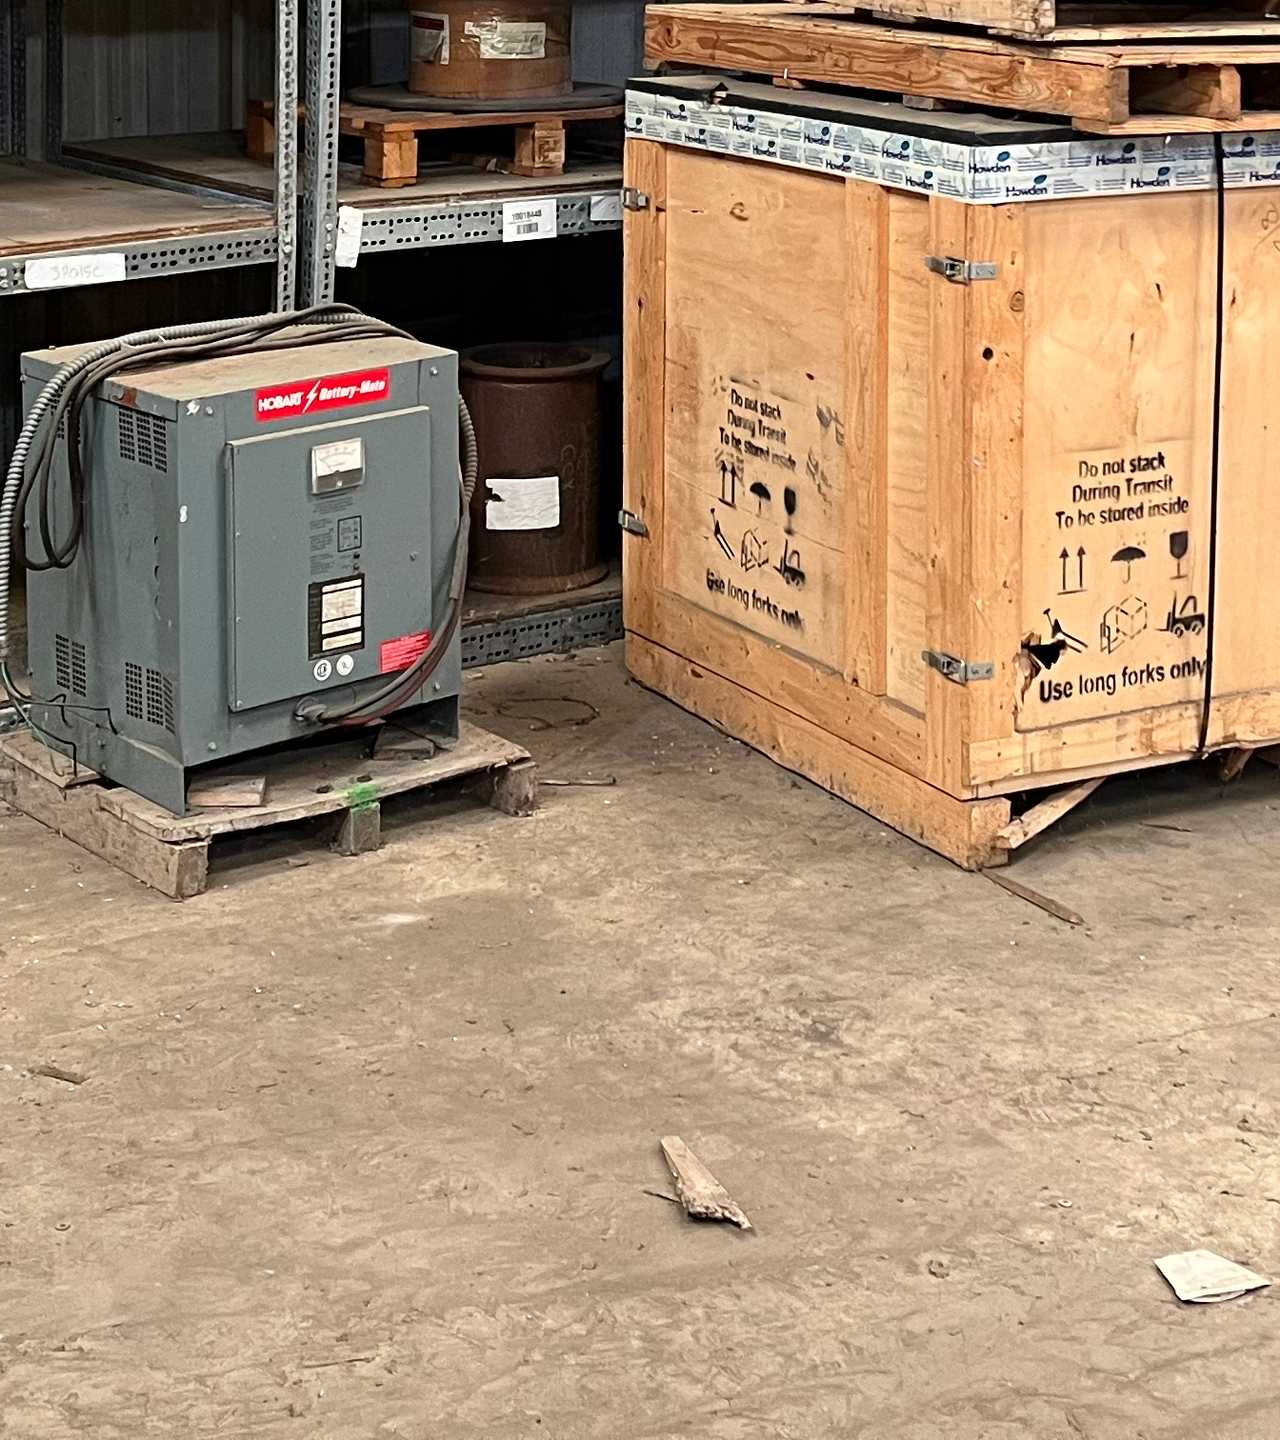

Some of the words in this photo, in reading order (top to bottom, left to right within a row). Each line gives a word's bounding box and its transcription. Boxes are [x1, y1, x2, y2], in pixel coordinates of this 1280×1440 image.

[968, 162, 1012, 174] Howden
[1096, 153, 1136, 166] Howden
[1006, 185, 1048, 198] Howden
[1131, 177, 1171, 189] Howden
[258, 391, 304, 413] HOBART
[731, 388, 743, 406] Do
[760, 401, 782, 421] stack
[719, 426, 730, 446] To
[727, 409, 756, 438] During
[758, 419, 787, 445] Transit
[1078, 460, 1099, 478] Do
[1102, 457, 1125, 476] not
[1129, 451, 1166, 474] stack
[1072, 483, 1121, 504] During
[1125, 474, 1174, 497] Transit
[1055, 511, 1074, 530] To
[1078, 508, 1096, 527] be
[1100, 501, 1144, 525] stored
[1148, 496, 1190, 518] inside
[728, 578, 750, 610] long
[752, 589, 779, 620] forks
[1039, 679, 1073, 703] Use
[1079, 674, 1117, 696] long
[1122, 663, 1166, 687] forks
[1170, 656, 1207, 681] only
